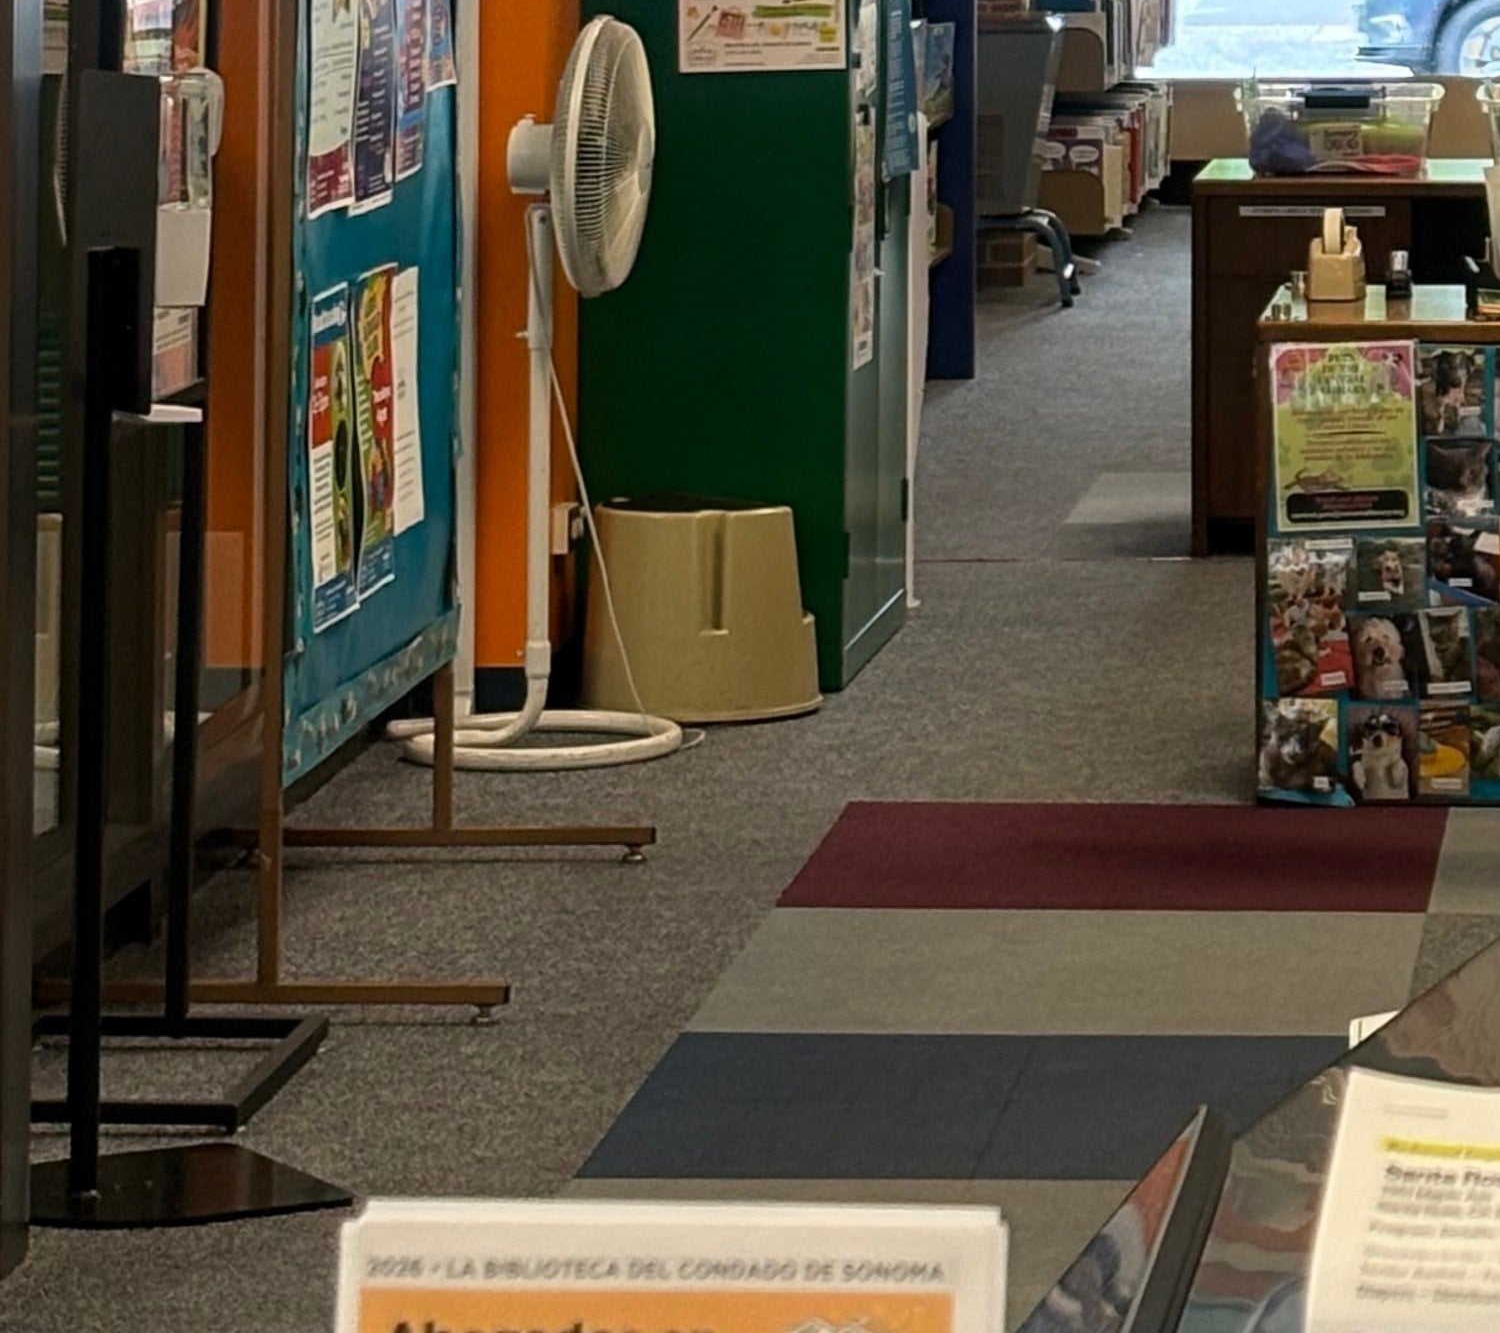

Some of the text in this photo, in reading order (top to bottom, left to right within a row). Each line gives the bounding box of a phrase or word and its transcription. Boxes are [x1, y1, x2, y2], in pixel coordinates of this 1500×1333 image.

[1384, 1164, 1457, 1189] Santa
[444, 1257, 474, 1280] LA
[482, 1257, 620, 1282] BIBLIOTECA
[627, 1259, 667, 1282] DEL
[676, 1259, 798, 1283] CONDADO
[803, 1260, 834, 1283] DE
[841, 1261, 945, 1284] SONOMA
